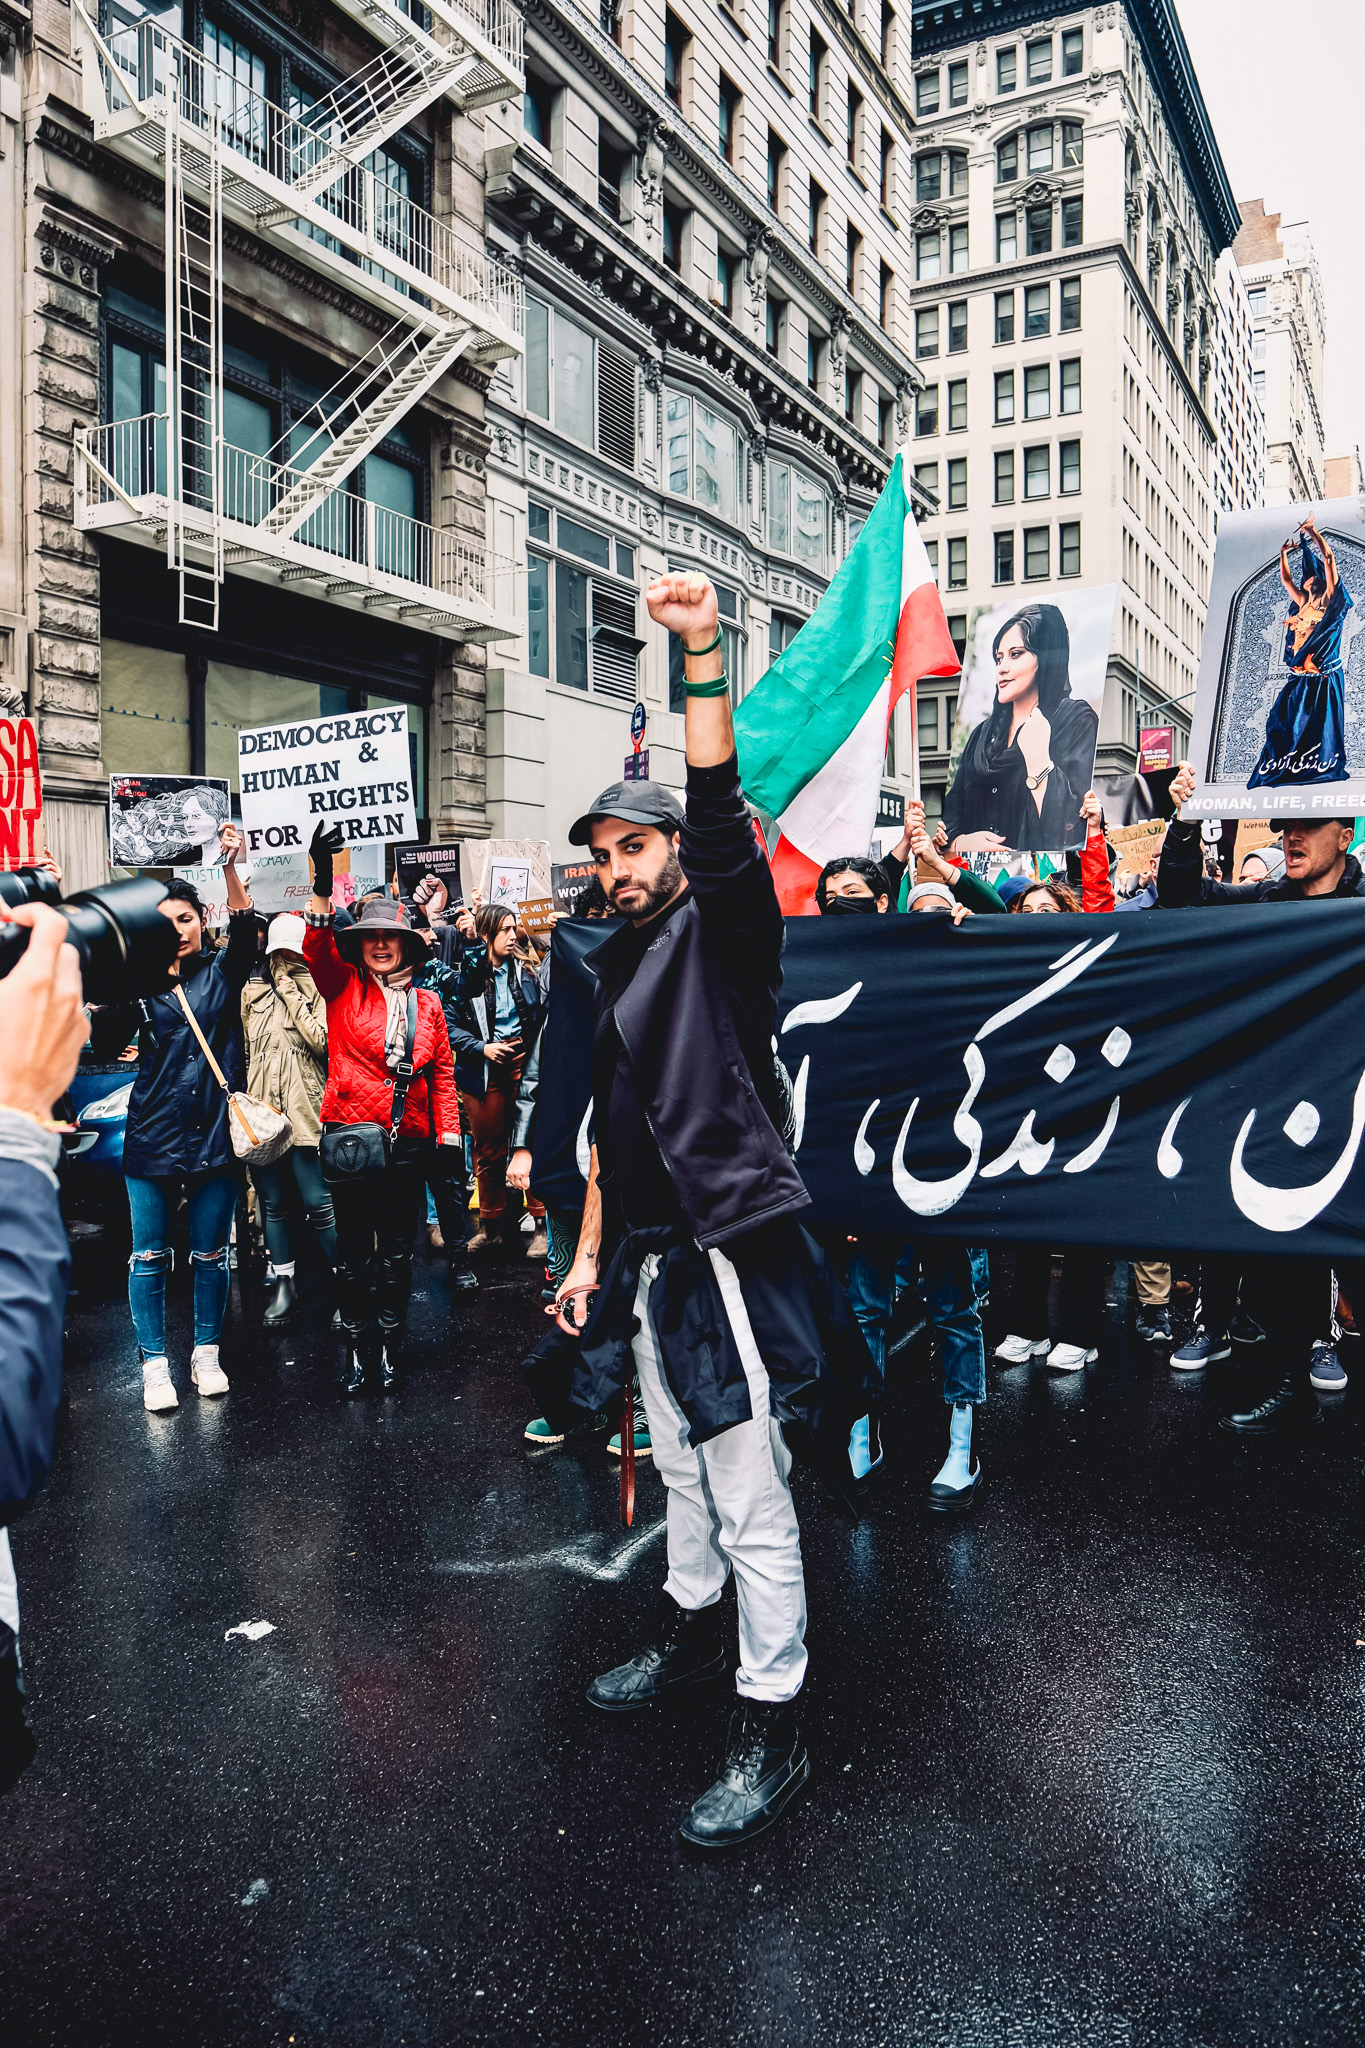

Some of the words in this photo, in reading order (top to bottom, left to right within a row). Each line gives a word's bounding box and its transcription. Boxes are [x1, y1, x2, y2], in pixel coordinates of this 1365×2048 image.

[239, 710, 406, 756] DEMOCRACY
[358, 741, 379, 763] &
[241, 760, 341, 794] HUMAN
[307, 780, 410, 814] RIGHTS
[1187, 796, 1257, 812] WOMAN,
[1262, 794, 1306, 811] LIFE,
[247, 824, 303, 851] FOR
[333, 813, 405, 841] IRAN
[250, 856, 293, 868] WOMAN
[416, 849, 456, 863] women
[433, 861, 456, 869] women's
[564, 864, 597, 879] IRAN
[180, 868, 226, 882] JUSTI
[354, 874, 379, 884] Opening
[343, 883, 358, 896] Fall
